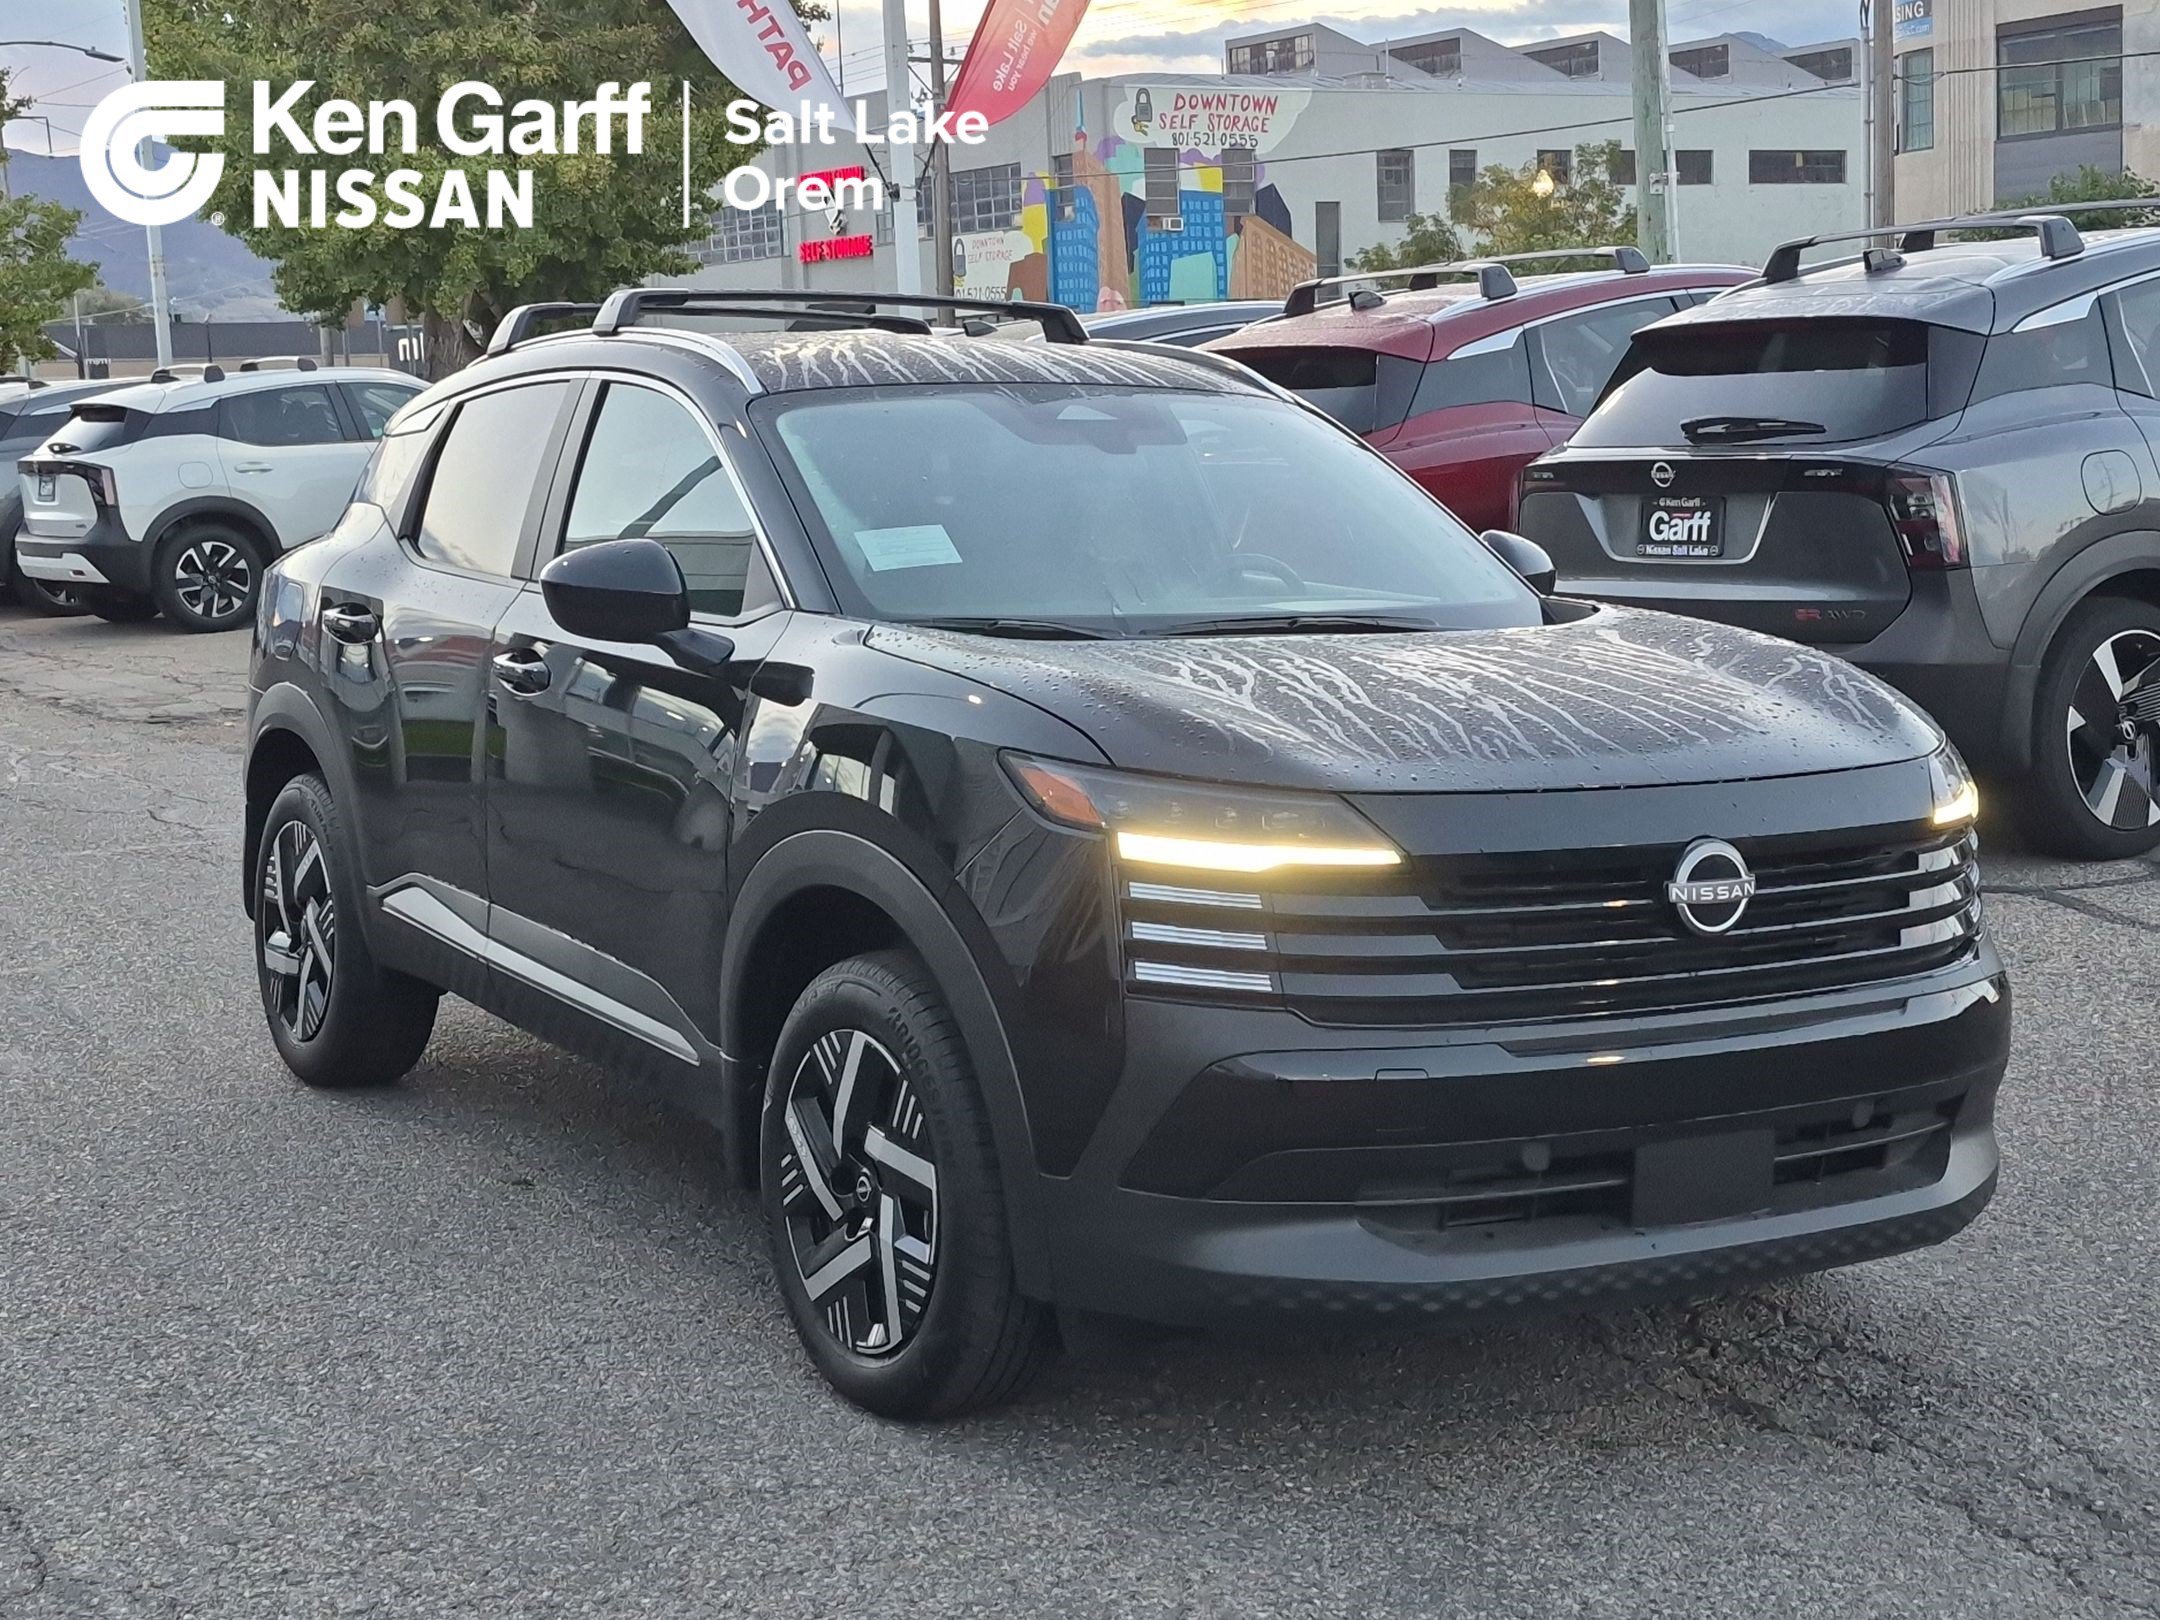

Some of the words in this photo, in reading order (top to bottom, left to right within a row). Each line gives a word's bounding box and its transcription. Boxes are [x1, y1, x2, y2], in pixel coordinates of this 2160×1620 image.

[1896, 1, 1924, 22] SING
[1173, 92, 1279, 115] DOWNTOWN
[1159, 112, 1199, 130] SELF
[1207, 113, 1270, 133] STORAGE
[1649, 510, 1711, 541] Garff
[1671, 880, 1756, 902] NISSAN
